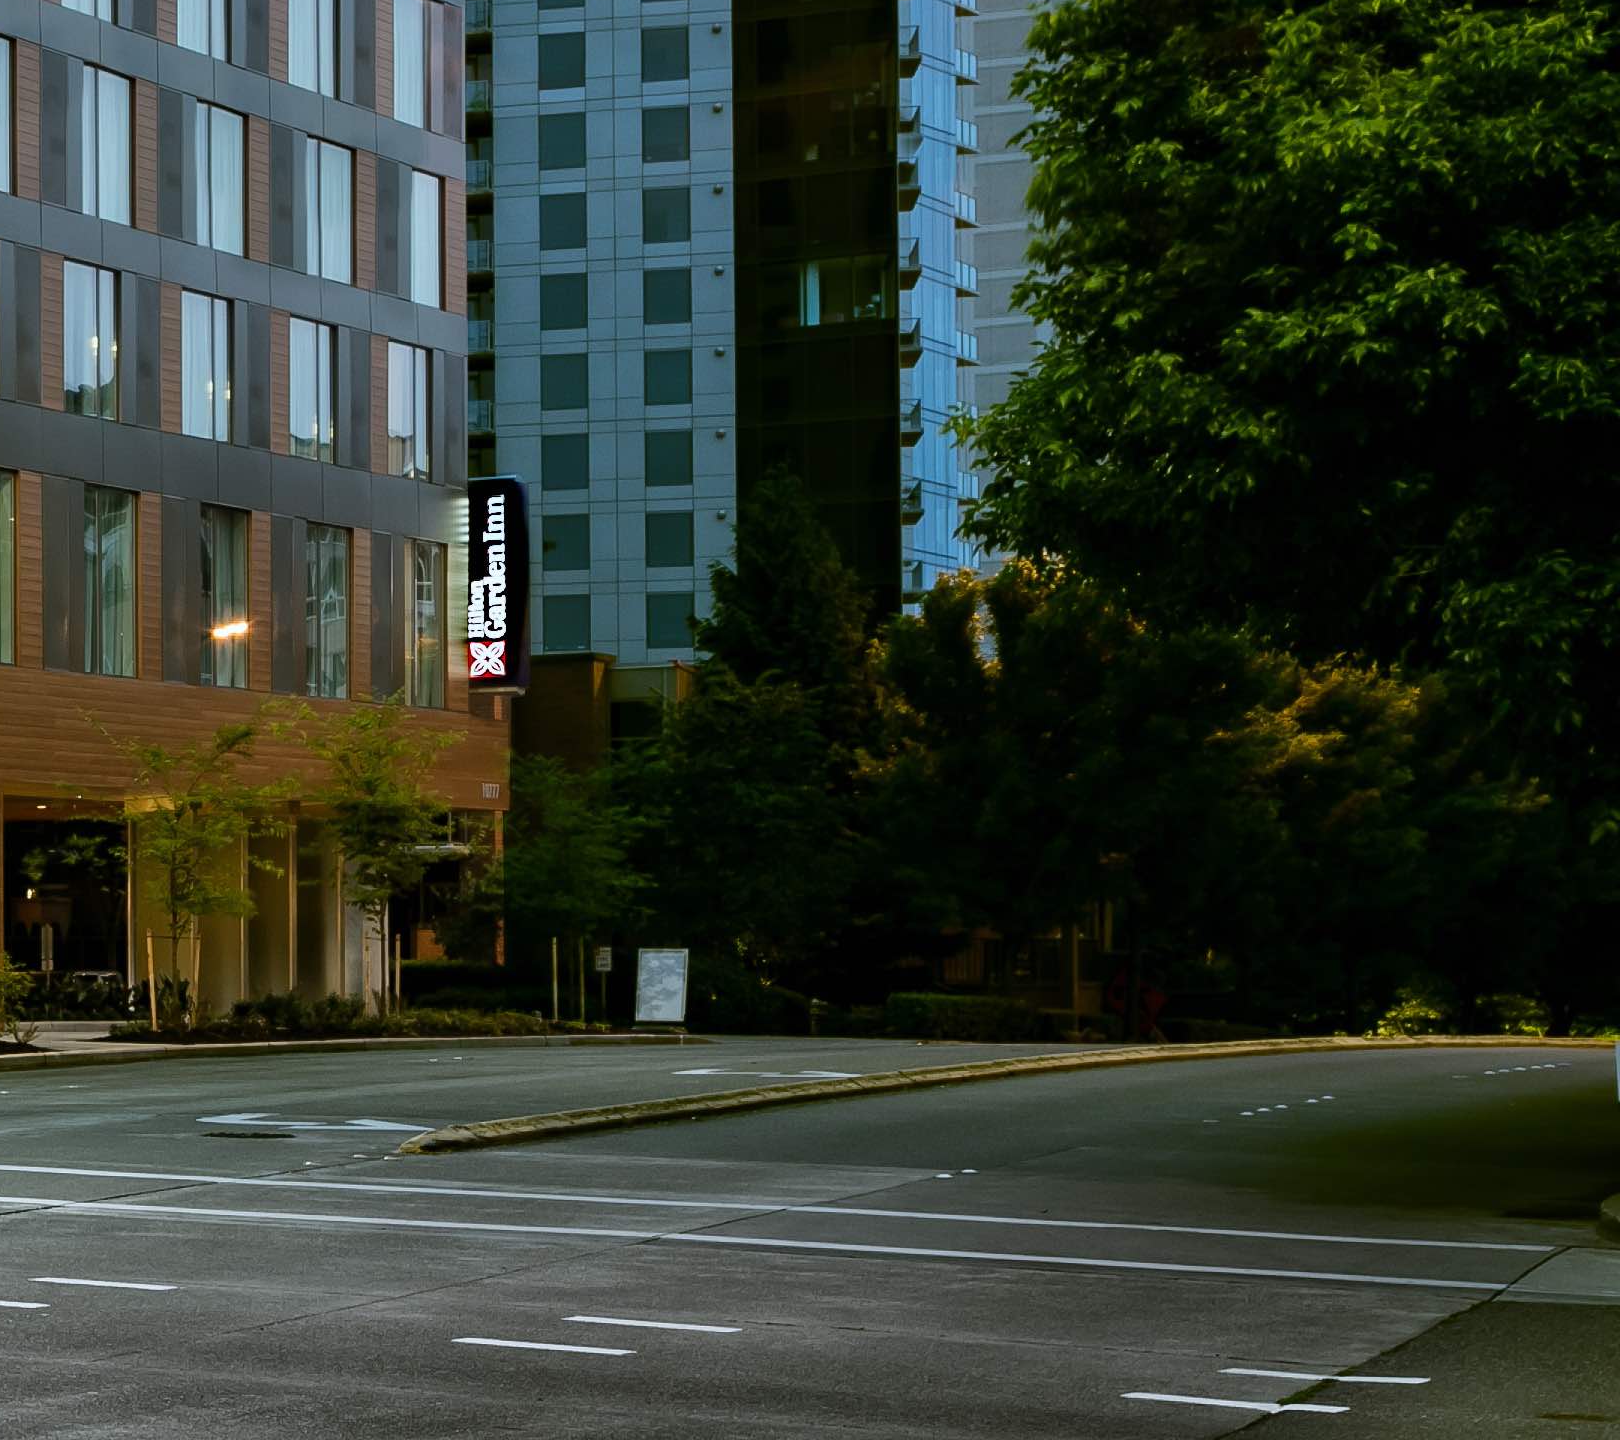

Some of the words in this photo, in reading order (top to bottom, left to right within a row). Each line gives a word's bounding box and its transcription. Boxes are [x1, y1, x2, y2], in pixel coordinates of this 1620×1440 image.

[483, 494, 505, 542] Inn
[468, 579, 484, 639] Hilton
[483, 542, 506, 639] Garden
